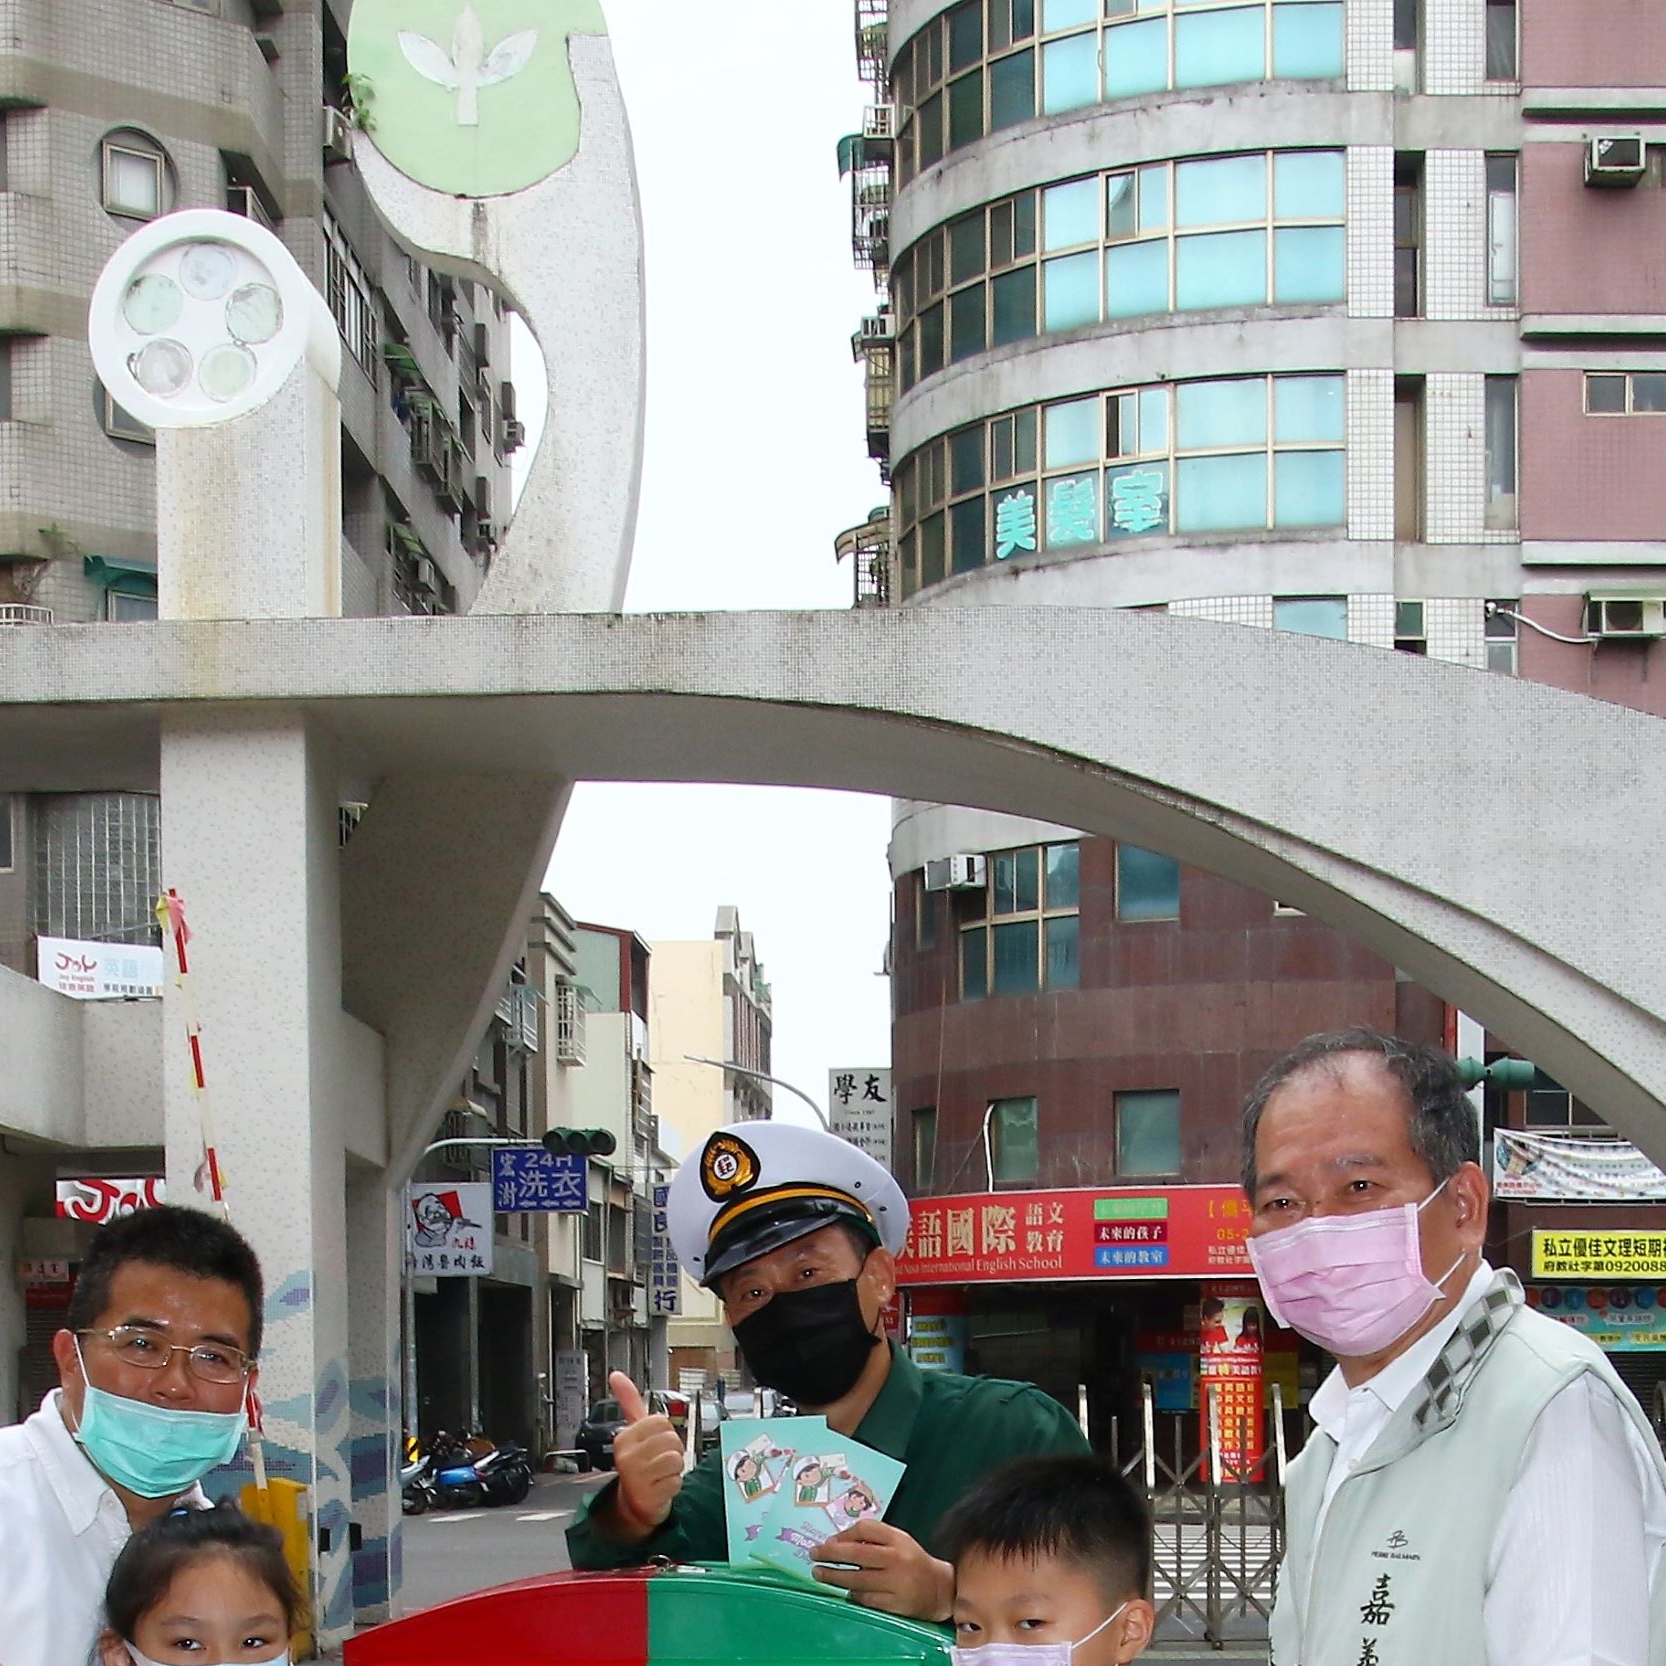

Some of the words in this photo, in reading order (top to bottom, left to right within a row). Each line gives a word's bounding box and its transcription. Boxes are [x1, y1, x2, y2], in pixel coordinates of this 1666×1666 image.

[834, 1074, 887, 1105] 學友
[519, 1170, 582, 1198] 洗衣
[1026, 1230, 1064, 1252] 教育
[1099, 1226, 1162, 1240] 未來的孩子
[976, 1257, 1016, 1274] English
[1019, 1256, 1062, 1270] School
[1100, 1250, 1163, 1264] 未來的教室
[654, 1290, 677, 1311] 行
